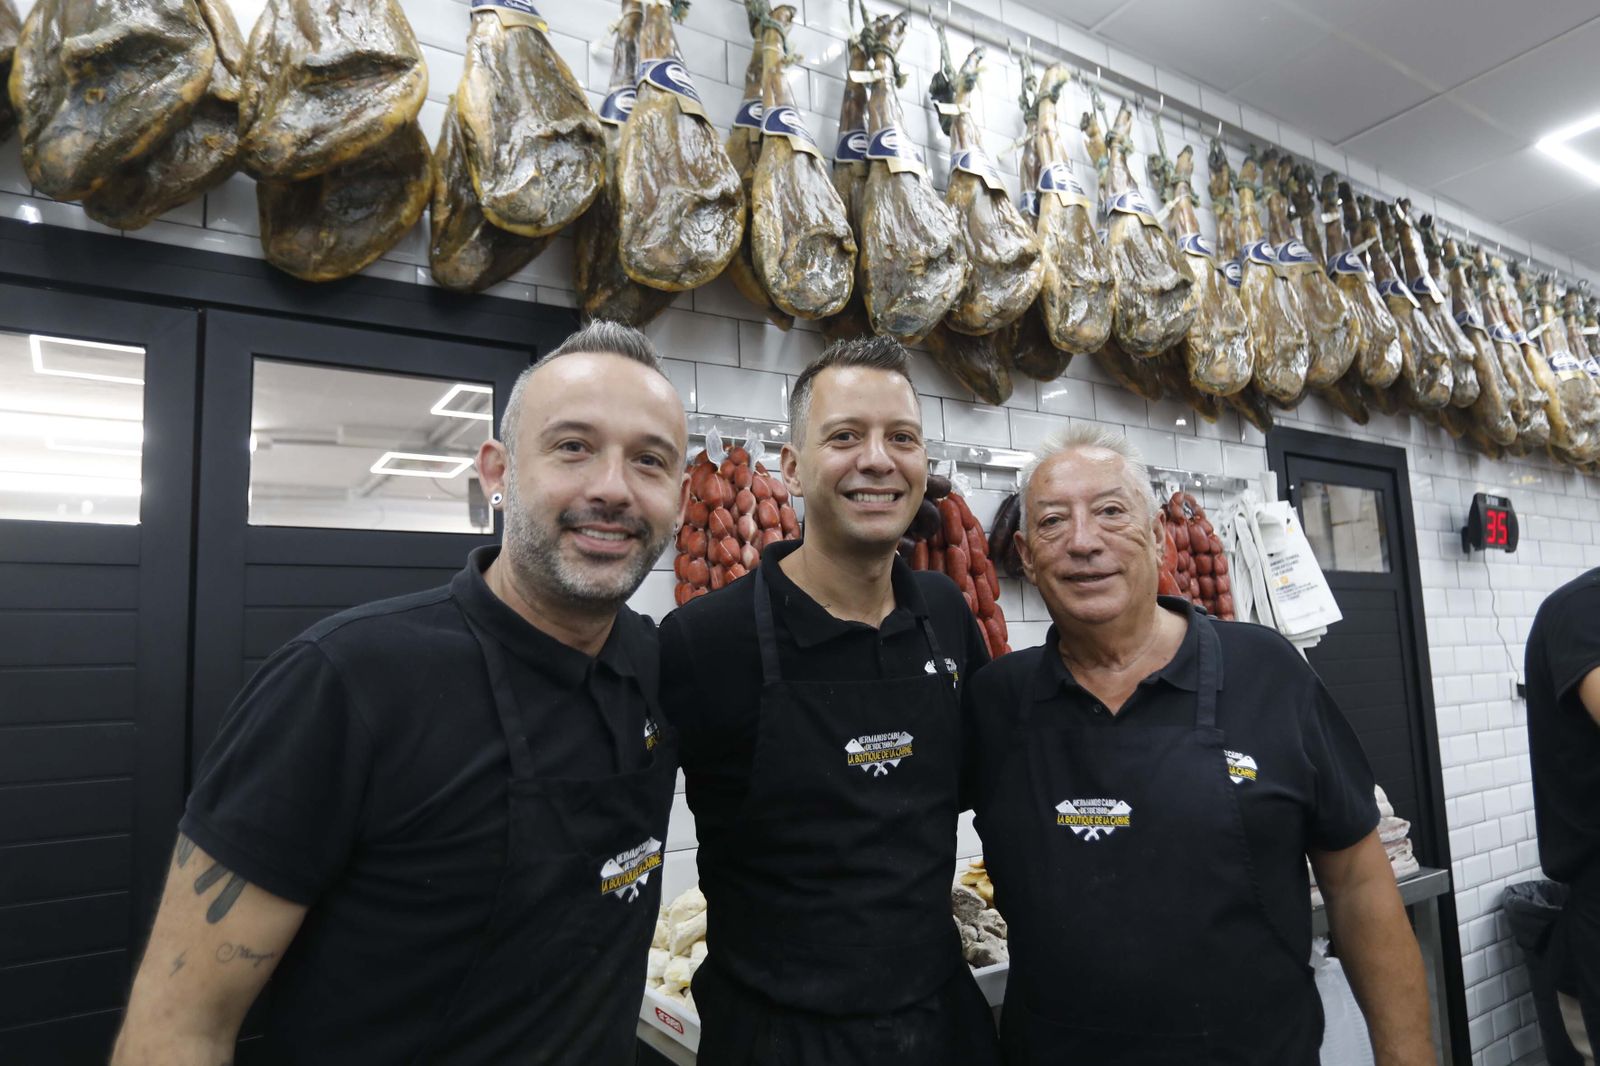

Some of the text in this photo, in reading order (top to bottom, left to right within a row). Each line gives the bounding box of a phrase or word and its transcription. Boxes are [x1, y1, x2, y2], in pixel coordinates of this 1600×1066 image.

[1487, 510, 1508, 545] 35
[848, 745, 912, 764] LA BOUTIQUE DE LA CARNE
[1057, 815, 1130, 826] LA BOUTIQUE DE LA CARNE
